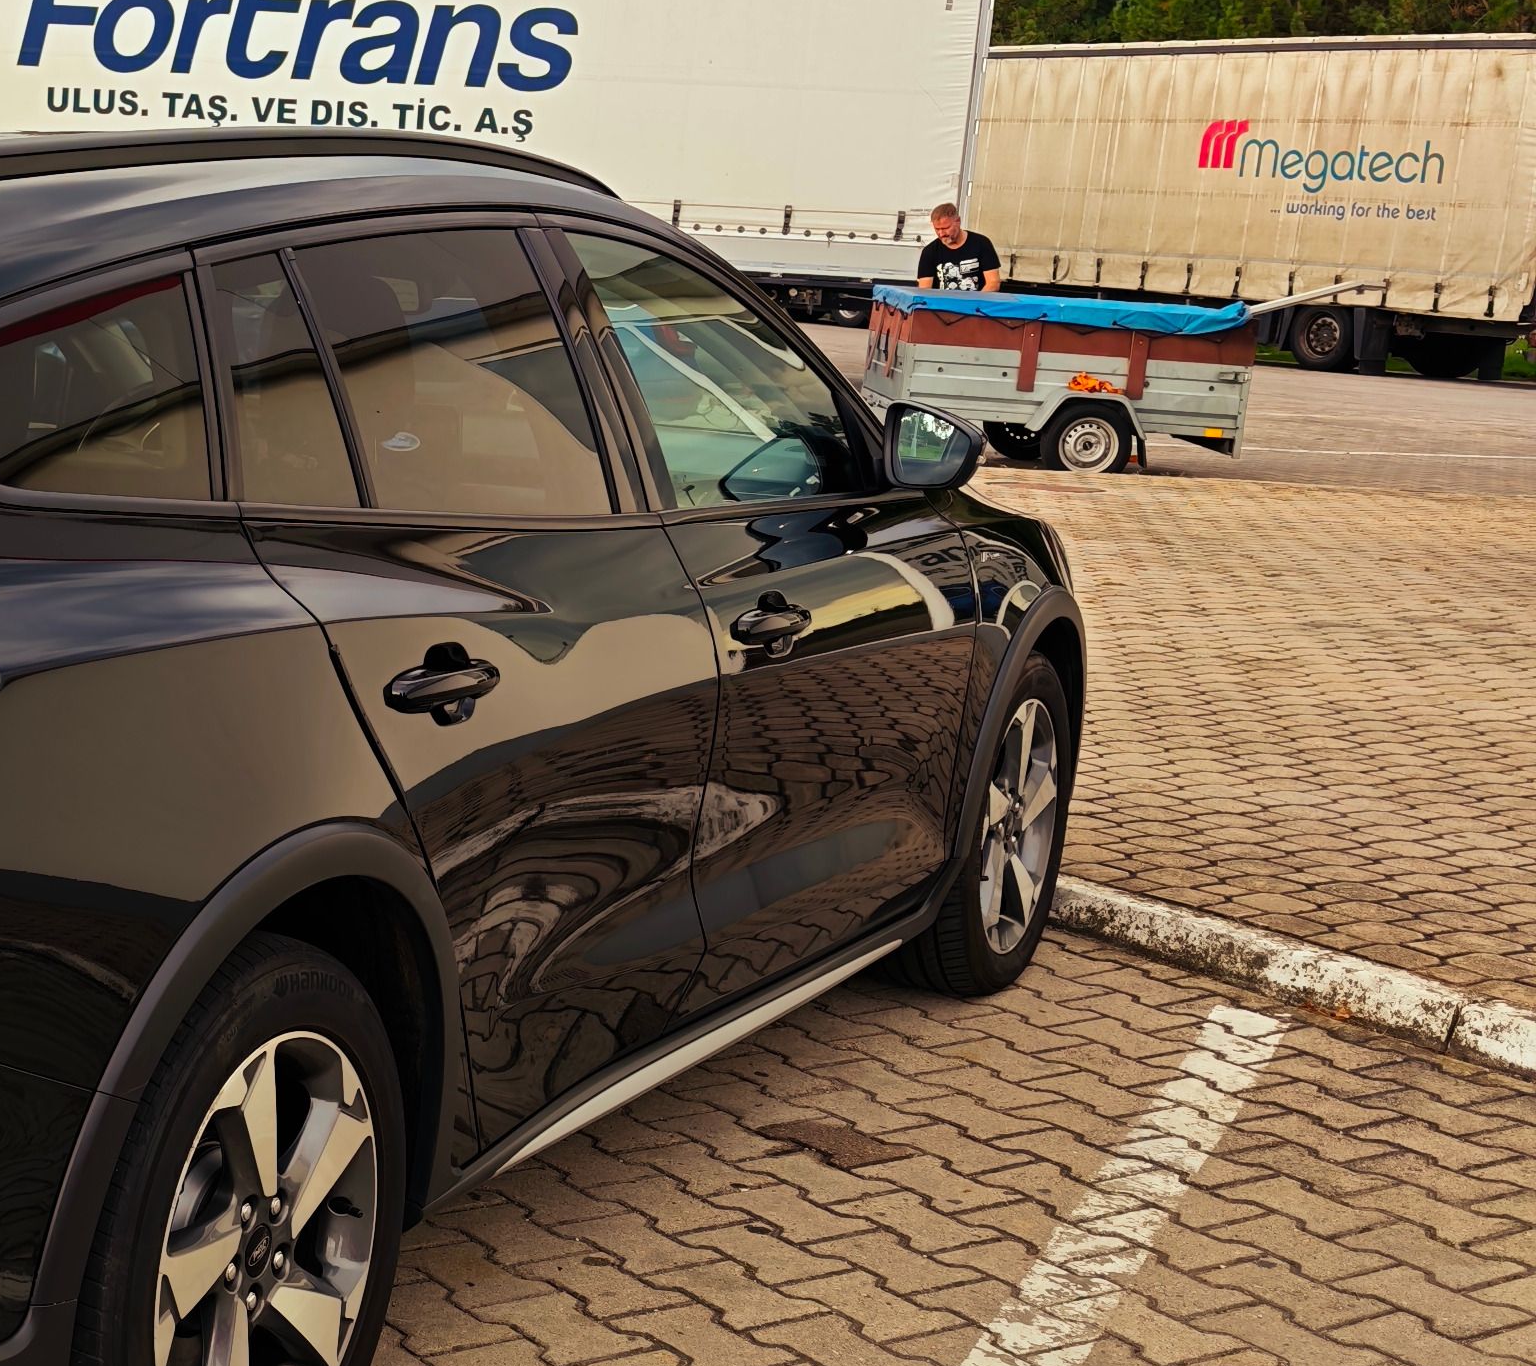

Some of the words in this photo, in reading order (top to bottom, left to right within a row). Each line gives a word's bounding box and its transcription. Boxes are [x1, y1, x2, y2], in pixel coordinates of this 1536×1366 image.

[47, 87, 149, 117] ULUS.
[162, 92, 238, 128] TAŞ.
[252, 97, 297, 124] VE
[393, 98, 462, 133] TİC.
[1238, 138, 1445, 194] Megatech
[1286, 201, 1346, 221] working
[1350, 202, 1371, 218] for
[1376, 203, 1400, 220] the
[1406, 204, 1436, 221] best
